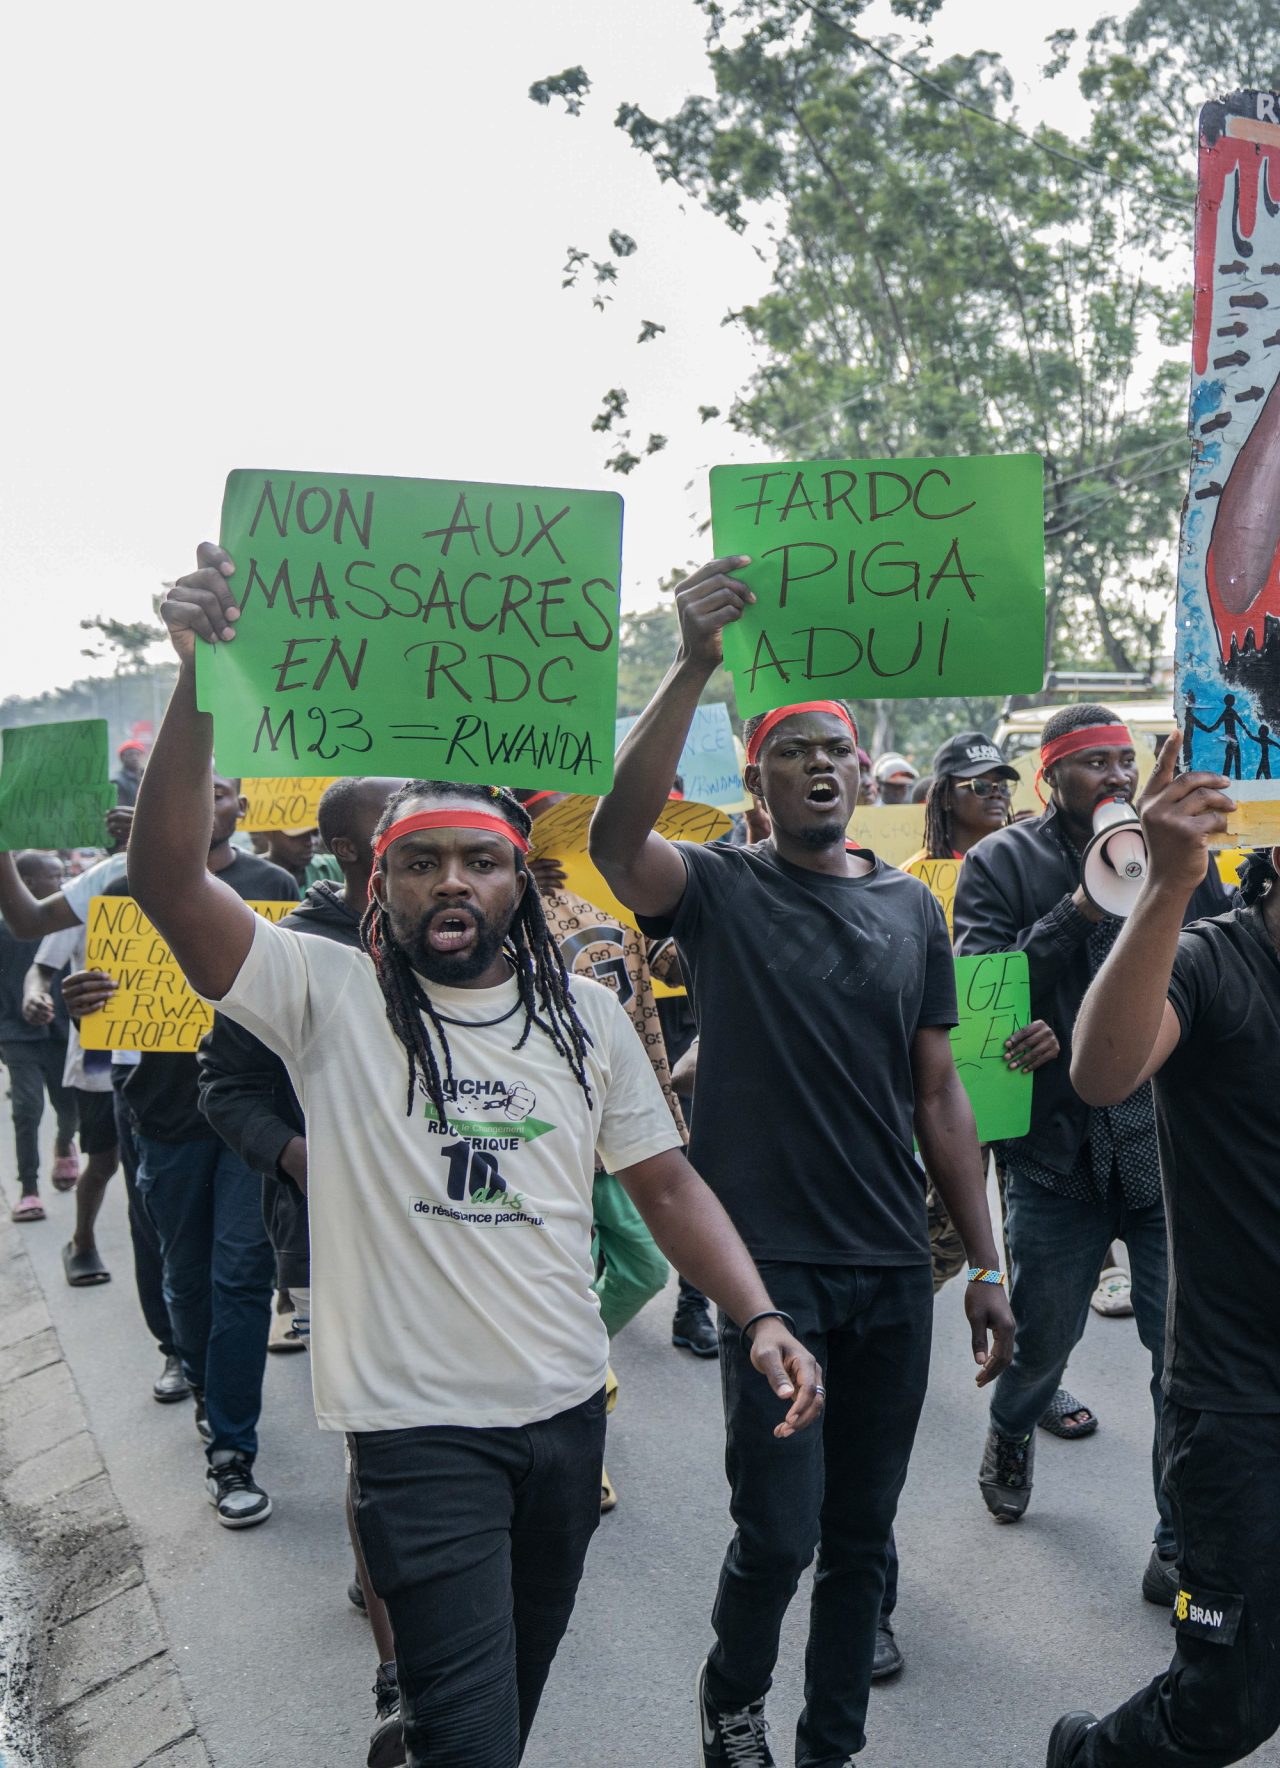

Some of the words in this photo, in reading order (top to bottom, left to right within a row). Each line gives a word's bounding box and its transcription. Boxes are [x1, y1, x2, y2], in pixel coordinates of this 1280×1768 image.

[249, 480, 374, 549] NON
[423, 492, 571, 564] AUX
[735, 469, 976, 525] FARDC
[238, 559, 616, 652] MASSACRES
[761, 538, 984, 608] PIGA
[272, 635, 368, 692] EN
[404, 641, 578, 704] RDC
[253, 706, 373, 760] M23
[445, 714, 602, 776] RWANDA
[87, 938, 142, 963] UNE
[442, 1079, 508, 1096] UCHA
[414, 1200, 430, 1213] de
[494, 1211, 545, 1227] pacifiqu
